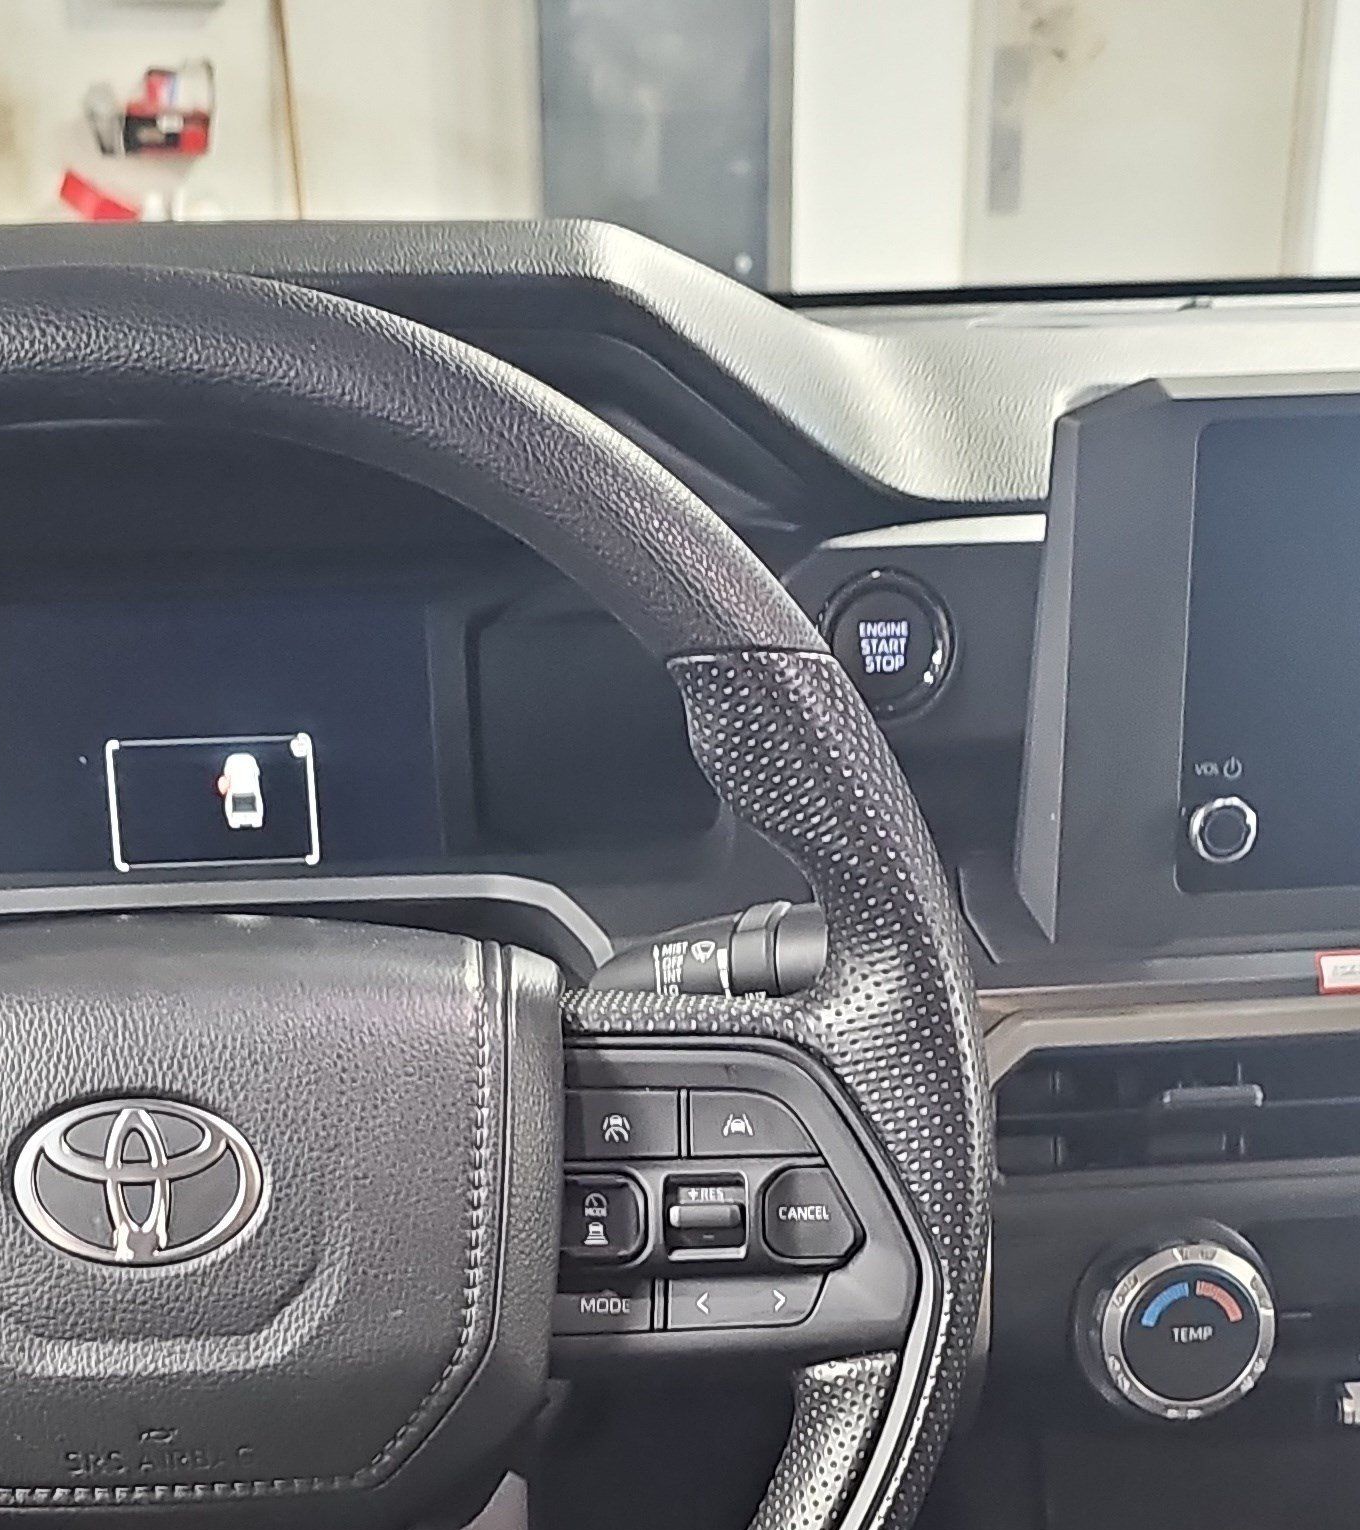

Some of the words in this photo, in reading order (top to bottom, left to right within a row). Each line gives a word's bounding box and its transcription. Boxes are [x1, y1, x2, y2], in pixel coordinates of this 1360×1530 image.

[858, 620, 909, 637] ENGINE
[860, 638, 907, 655] START
[865, 655, 905, 674] STOP
[778, 1204, 830, 1222] CANCEL
[580, 1297, 631, 1315] MODE
[1171, 1325, 1213, 1343] TEMP
